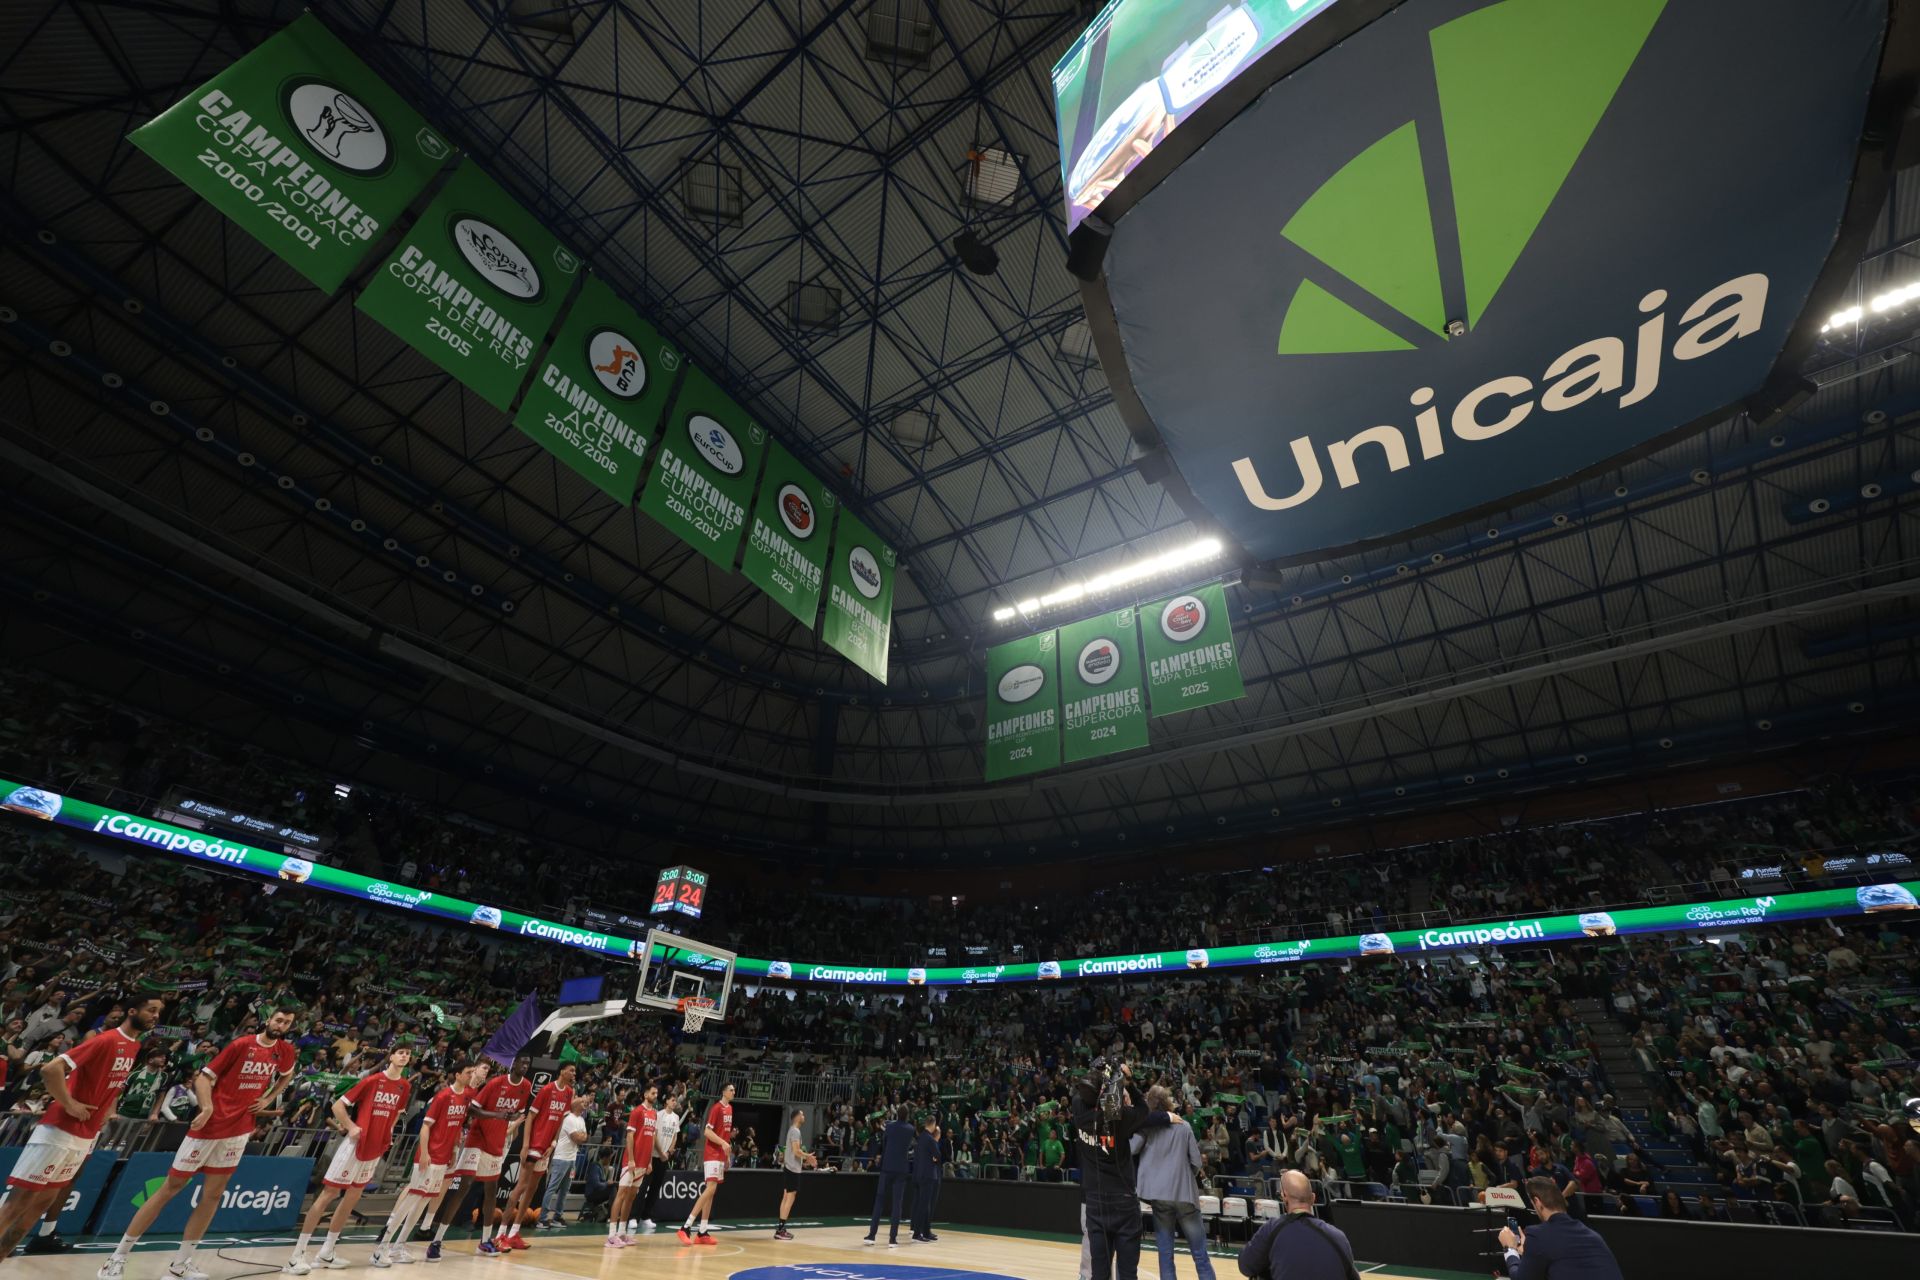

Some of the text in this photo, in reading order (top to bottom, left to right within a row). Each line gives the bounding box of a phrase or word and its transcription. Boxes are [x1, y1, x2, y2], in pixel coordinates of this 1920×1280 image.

[196, 113, 357, 247] COPA KORAC
[199, 89, 379, 241] CAMPEONES
[197, 148, 322, 250] 2000/2001
[389, 262, 527, 371] COPA DEL REY
[400, 245, 534, 361] CAMPEONES
[425, 317, 471, 357] 2005
[616, 358, 638, 392] ACB
[1231, 273, 1769, 511] Unicaja
[542, 363, 647, 458] CAMPEONES
[544, 412, 617, 476] 2005/2006
[563, 409, 614, 455] ACB
[694, 431, 734, 472] EuroCup
[660, 448, 744, 527] CAMPEONES
[660, 472, 734, 533] EUROCUP
[665, 495, 721, 543] 2016/2017
[750, 534, 820, 596] COPA DEL REY
[754, 518, 821, 585] CAMPEONES
[771, 569, 794, 594] 2023
[831, 584, 888, 640] CAMPEONES
[1150, 642, 1232, 677] CAMPEONES
[1152, 658, 1233, 686] COPA DEL REY
[1065, 688, 1139, 719] CAMPEONES
[1181, 682, 1209, 697] 2025
[988, 709, 1055, 740] CAMPEONES
[1066, 705, 1142, 730] SUPERCOPA
[1090, 725, 1117, 740] 2024
[1009, 746, 1032, 760] 2024
[93, 814, 248, 864] ¡Campeón!
[661, 869, 679, 880] 3:00
[686, 870, 705, 885] 3:00
[367, 884, 394, 897] Copa
[655, 882, 676, 903] 24
[679, 884, 702, 907] 24
[1686, 906, 1766, 921] Copa del Rey
[1691, 905, 1711, 913] acb
[1716, 918, 1746, 926] Canaria
[519, 919, 608, 950] ¡Campeón!
[1418, 921, 1545, 950] ¡Campeón!
[1078, 954, 1163, 977] ¡Campeón!
[1254, 950, 1278, 958] Copa
[1287, 947, 1304, 956] Rey
[809, 966, 887, 983] ¡Campeón!
[374, 1090, 400, 1106] BAXI
[447, 1104, 467, 1115] BAXI
[495, 1097, 521, 1109] BAXI
